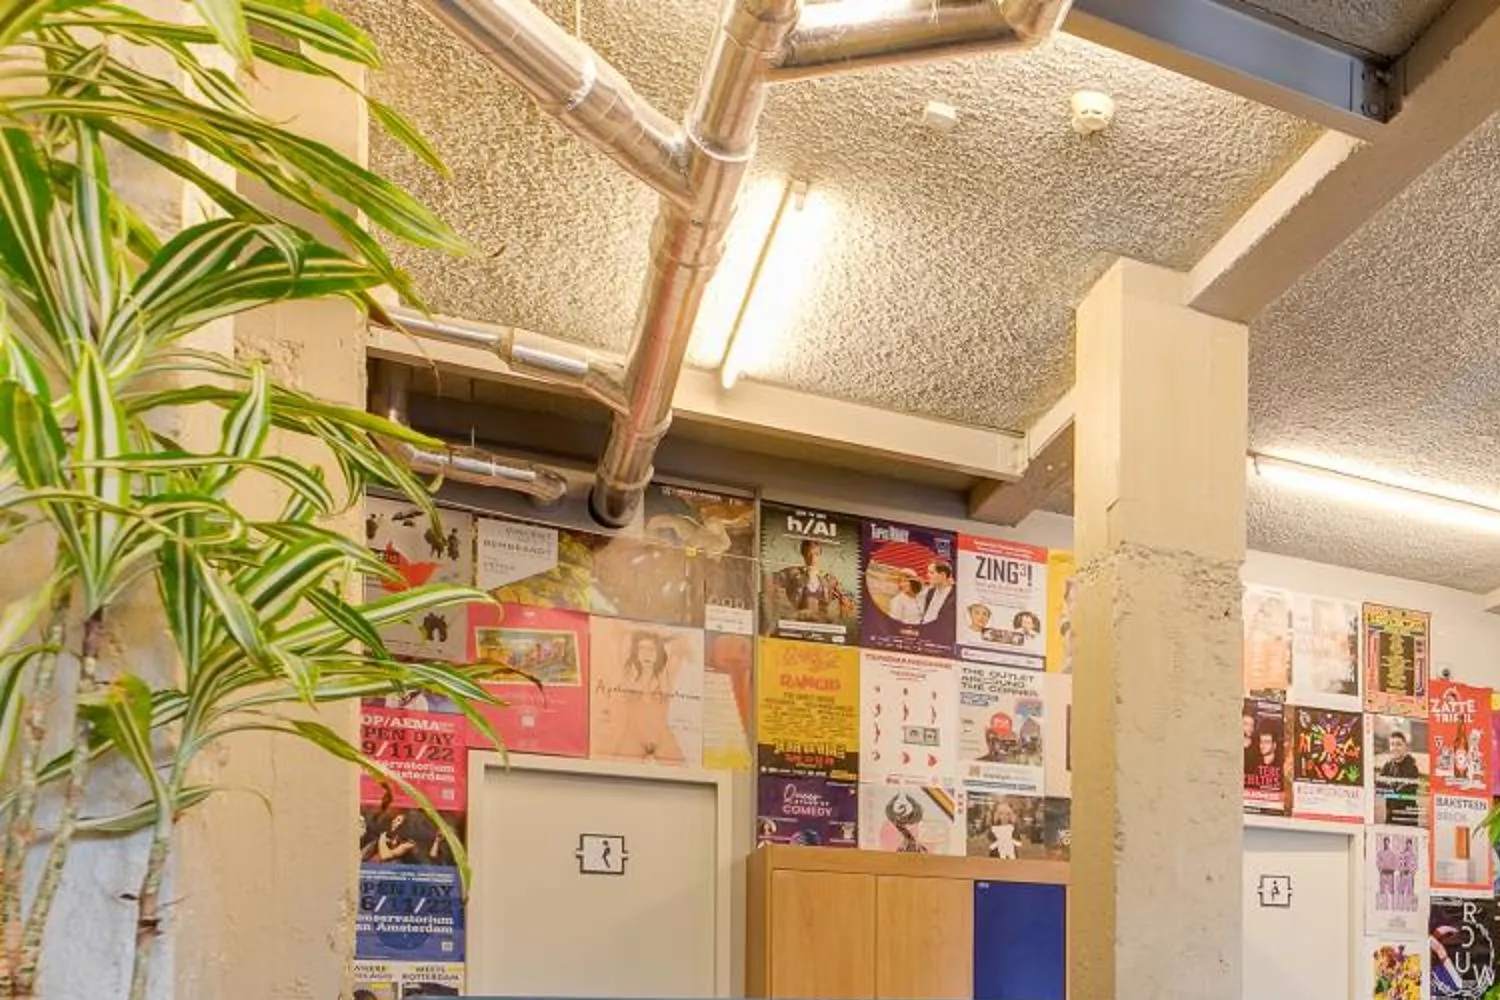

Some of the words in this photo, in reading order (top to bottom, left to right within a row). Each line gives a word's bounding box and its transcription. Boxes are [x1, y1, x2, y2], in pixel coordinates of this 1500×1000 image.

[365, 727, 405, 741] PEN
[414, 731, 455, 746] DAY
[361, 740, 455, 761] 9/11/22
[782, 805, 833, 817] COMEDY
[359, 913, 454, 925] onservatorium
[356, 922, 371, 932] an
[376, 922, 454, 934] Amsterdam
